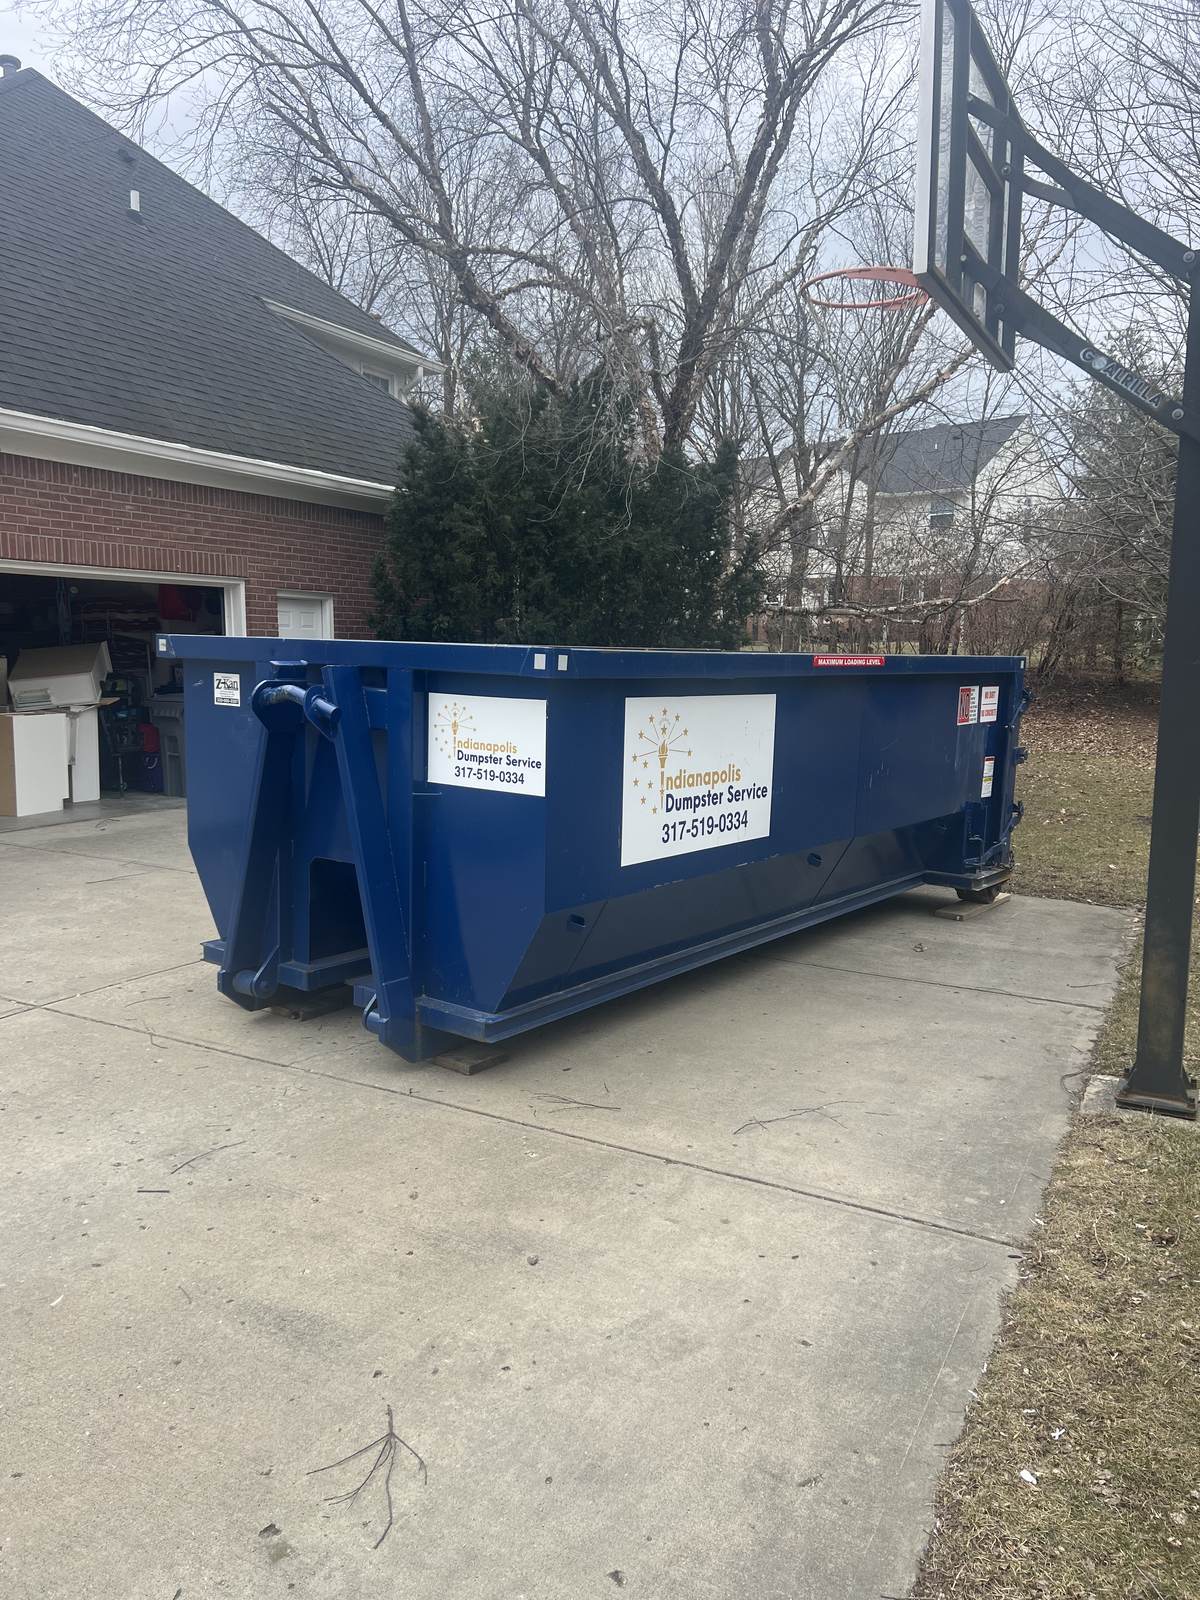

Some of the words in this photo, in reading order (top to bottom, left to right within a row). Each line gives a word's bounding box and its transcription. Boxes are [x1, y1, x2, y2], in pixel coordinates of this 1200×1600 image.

[1079, 347, 1162, 409] GOALRILLA
[454, 765, 525, 784] 317-519-0334
[457, 750, 502, 766] Dumpster
[505, 754, 542, 769] Service
[660, 763, 741, 792] Indianapolis
[665, 789, 724, 813] Dumpster
[727, 782, 768, 803] Service
[661, 809, 748, 844] 317-519-0334
